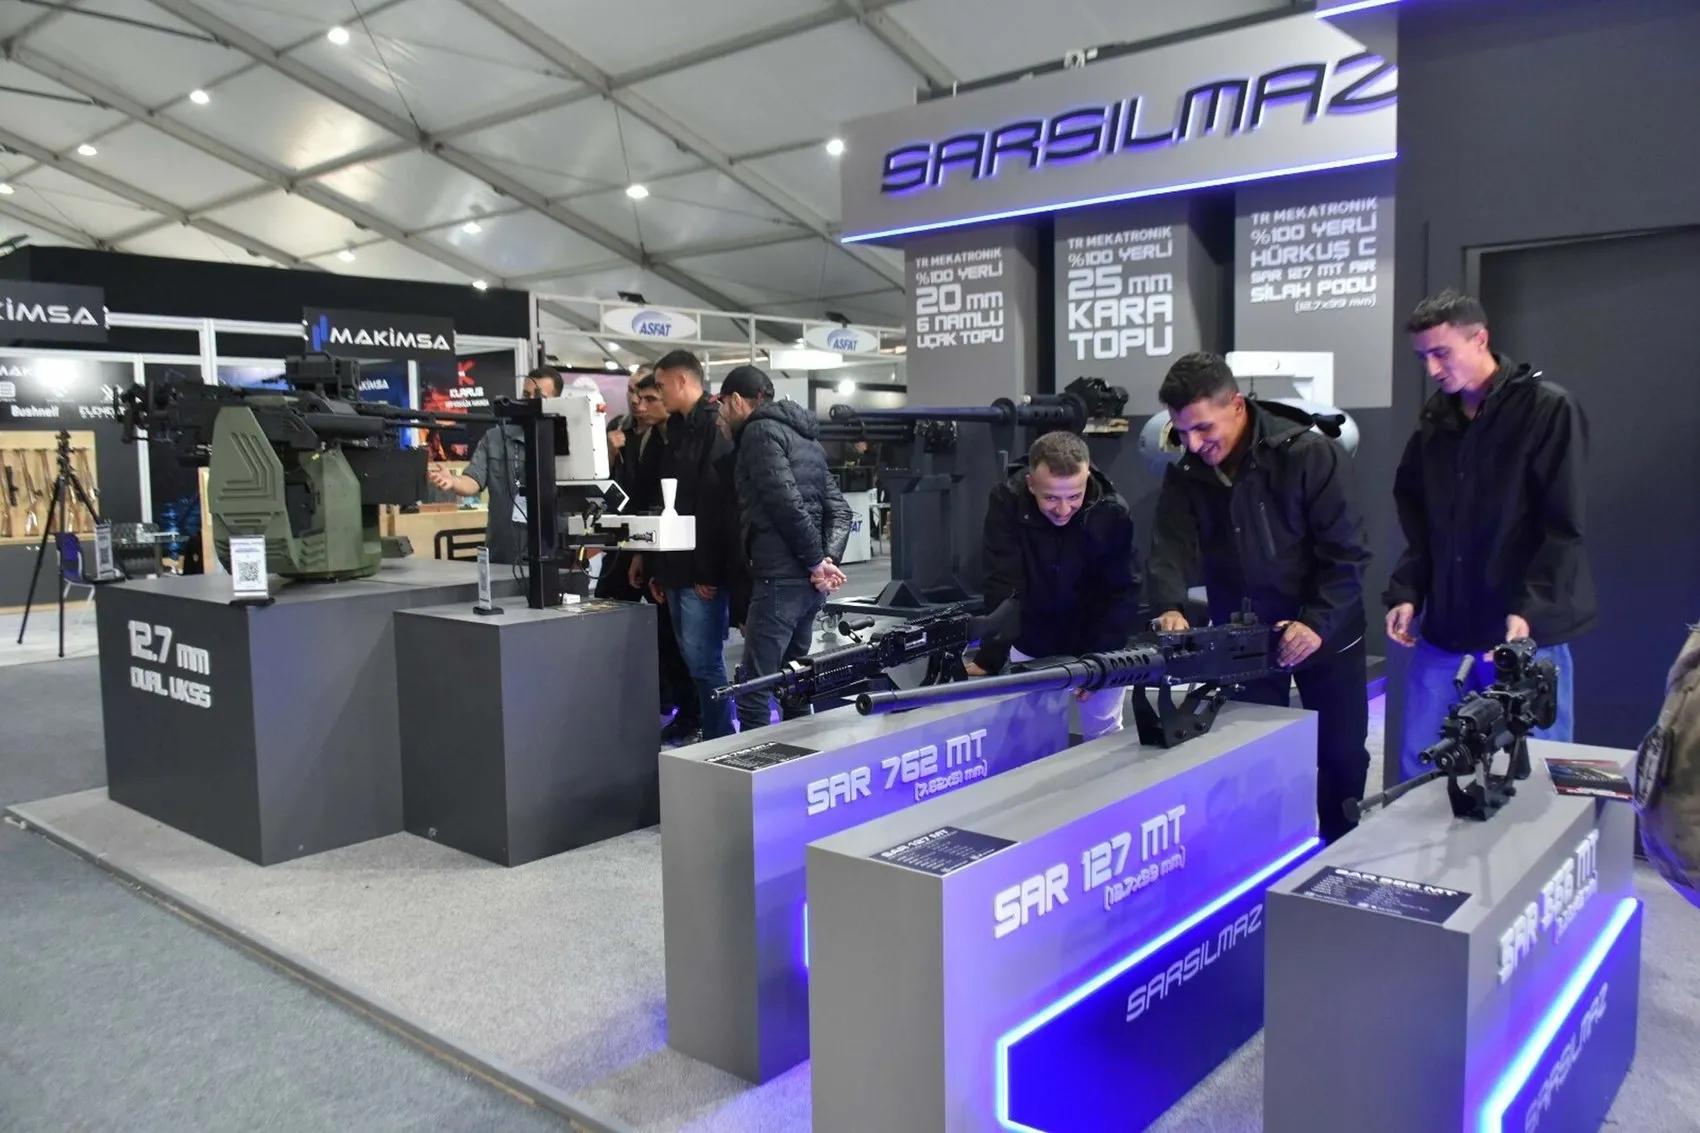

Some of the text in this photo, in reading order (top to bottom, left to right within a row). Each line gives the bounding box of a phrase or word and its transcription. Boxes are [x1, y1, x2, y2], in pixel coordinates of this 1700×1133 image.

[881, 53, 1397, 193] SARSILMAZ
[1251, 210, 1270, 225] TR
[1068, 237, 1084, 249] TR
[1250, 224, 1305, 245] %100
[1358, 236, 1377, 256] C
[915, 257, 928, 269] TR
[1068, 249, 1114, 267] %100
[915, 268, 954, 285] %100
[1068, 264, 1122, 300] 25
[1250, 268, 1282, 284] SAR
[1317, 261, 1344, 277] MT
[1317, 275, 1377, 297] PODU
[916, 283, 962, 315] 20
[0, 296, 98, 326] İMSA
[916, 309, 1004, 333] 6 NAMLU
[1068, 293, 1173, 330] KARA
[330, 327, 450, 350] MAKİMSA
[640, 322, 671, 337] ASFAT
[960, 328, 1004, 344] TOPU
[833, 338, 857, 351] ASFAT
[1068, 325, 1173, 361] TOPU
[128, 620, 172, 664] 12.7
[130, 666, 211, 708] DUAL UKSS
[807, 728, 987, 816] SAR 762 MT
[993, 804, 1186, 939] SAR 127 MT
[1498, 901, 1538, 985] SAR
[1126, 903, 1263, 1022] SARSILMAZ
